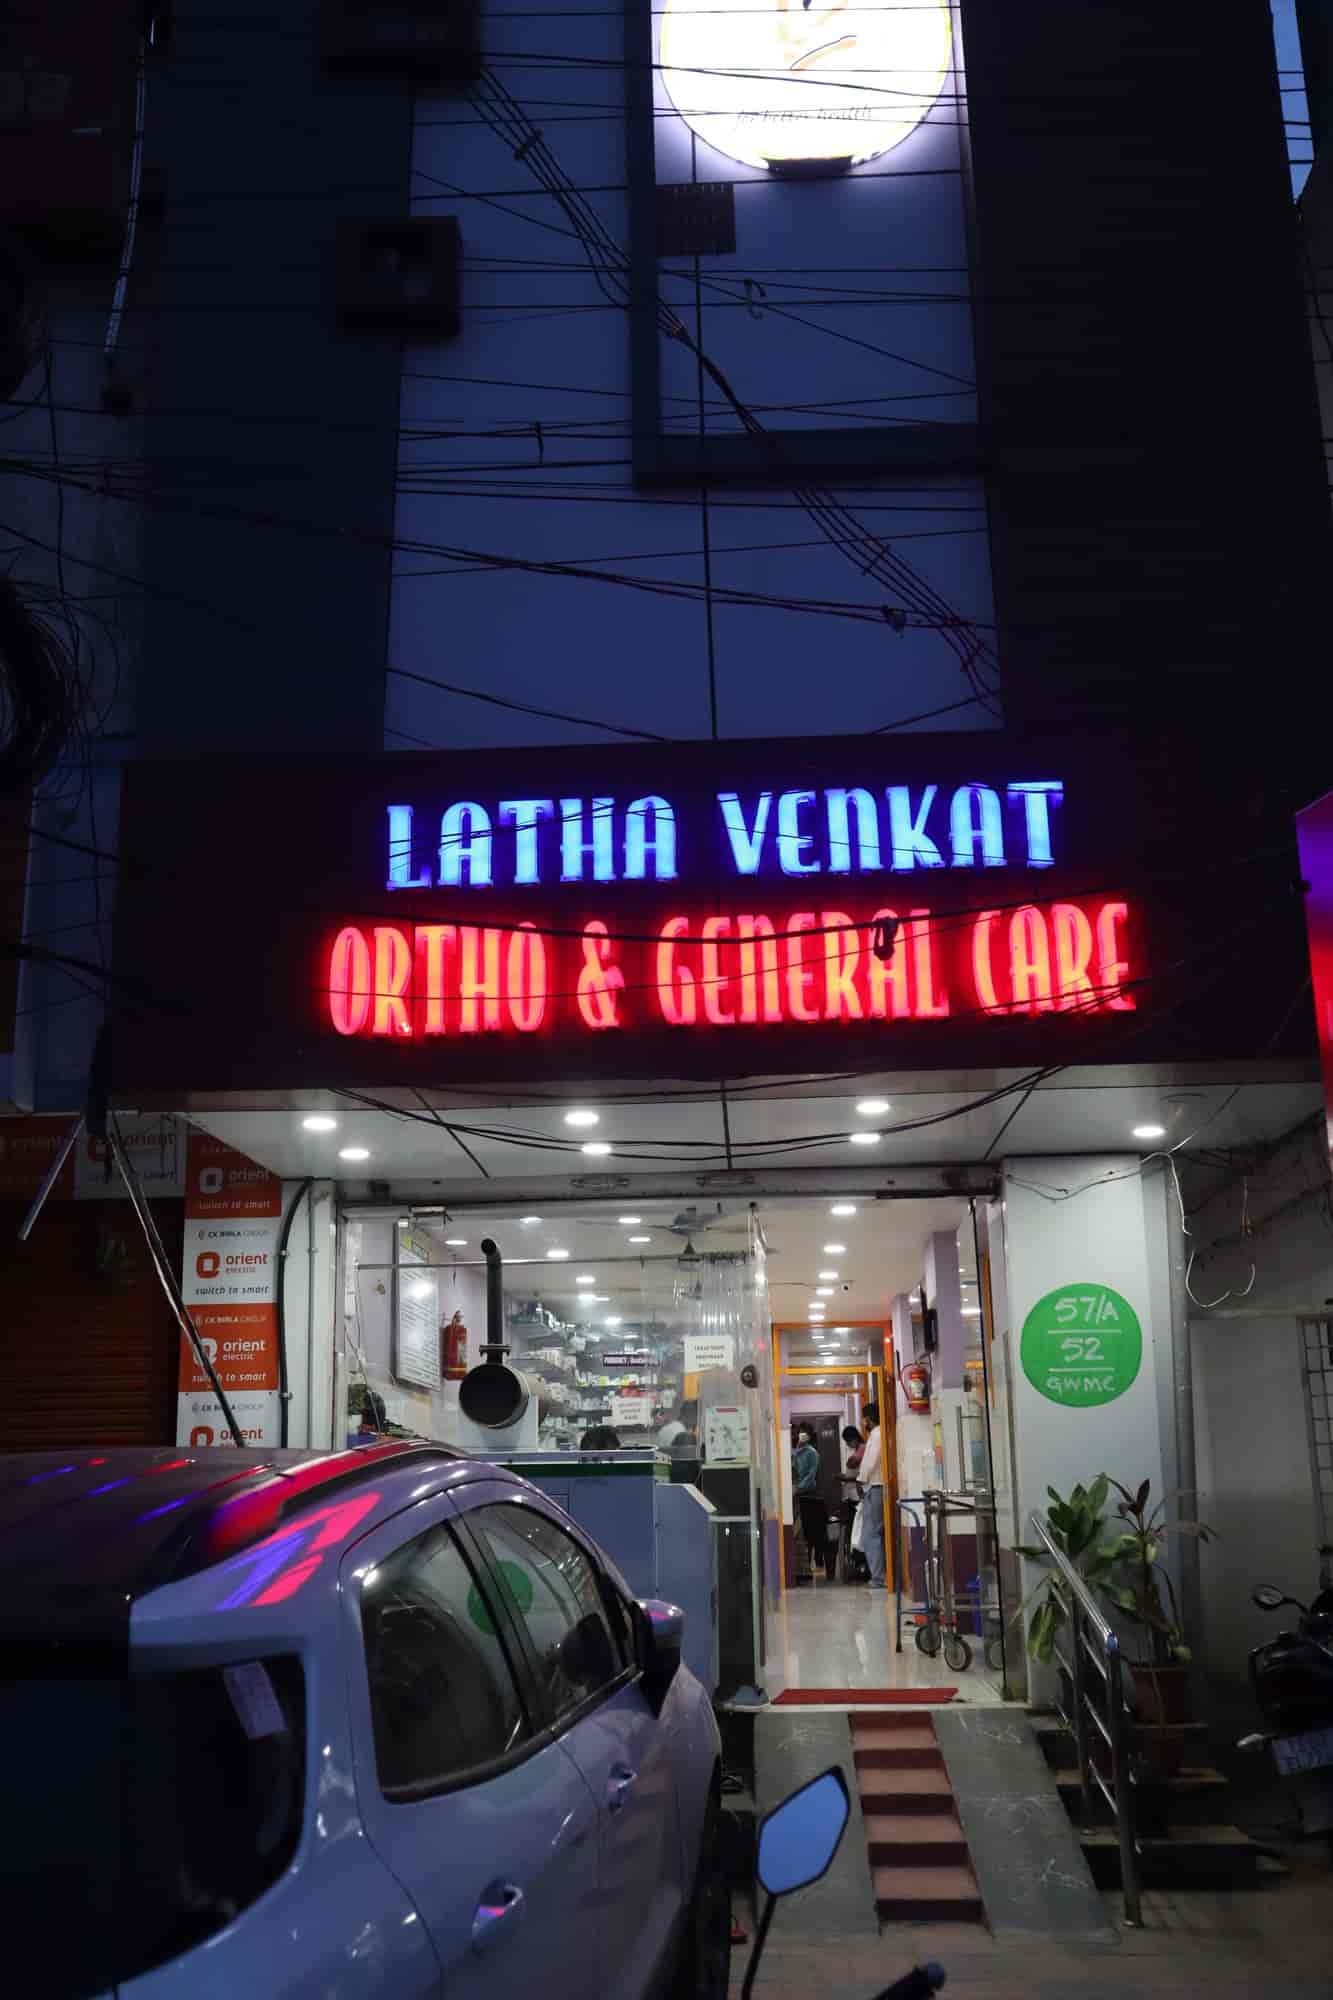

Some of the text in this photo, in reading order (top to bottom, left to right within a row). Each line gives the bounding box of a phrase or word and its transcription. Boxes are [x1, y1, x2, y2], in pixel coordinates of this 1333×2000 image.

[385, 779, 1065, 890] LATHA VENKAT
[328, 900, 1138, 1037] ORTHO & GENERAL CARE
[225, 1251, 269, 1265] orient
[242, 1285, 269, 1295] smart
[1053, 1292, 1120, 1325] 57/A
[223, 1339, 265, 1352] orient
[1060, 1337, 1105, 1363] 52
[222, 1352, 256, 1361] electric
[226, 1372, 236, 1382] to
[240, 1372, 266, 1381] smart
[1046, 1375, 1116, 1396] GWMC
